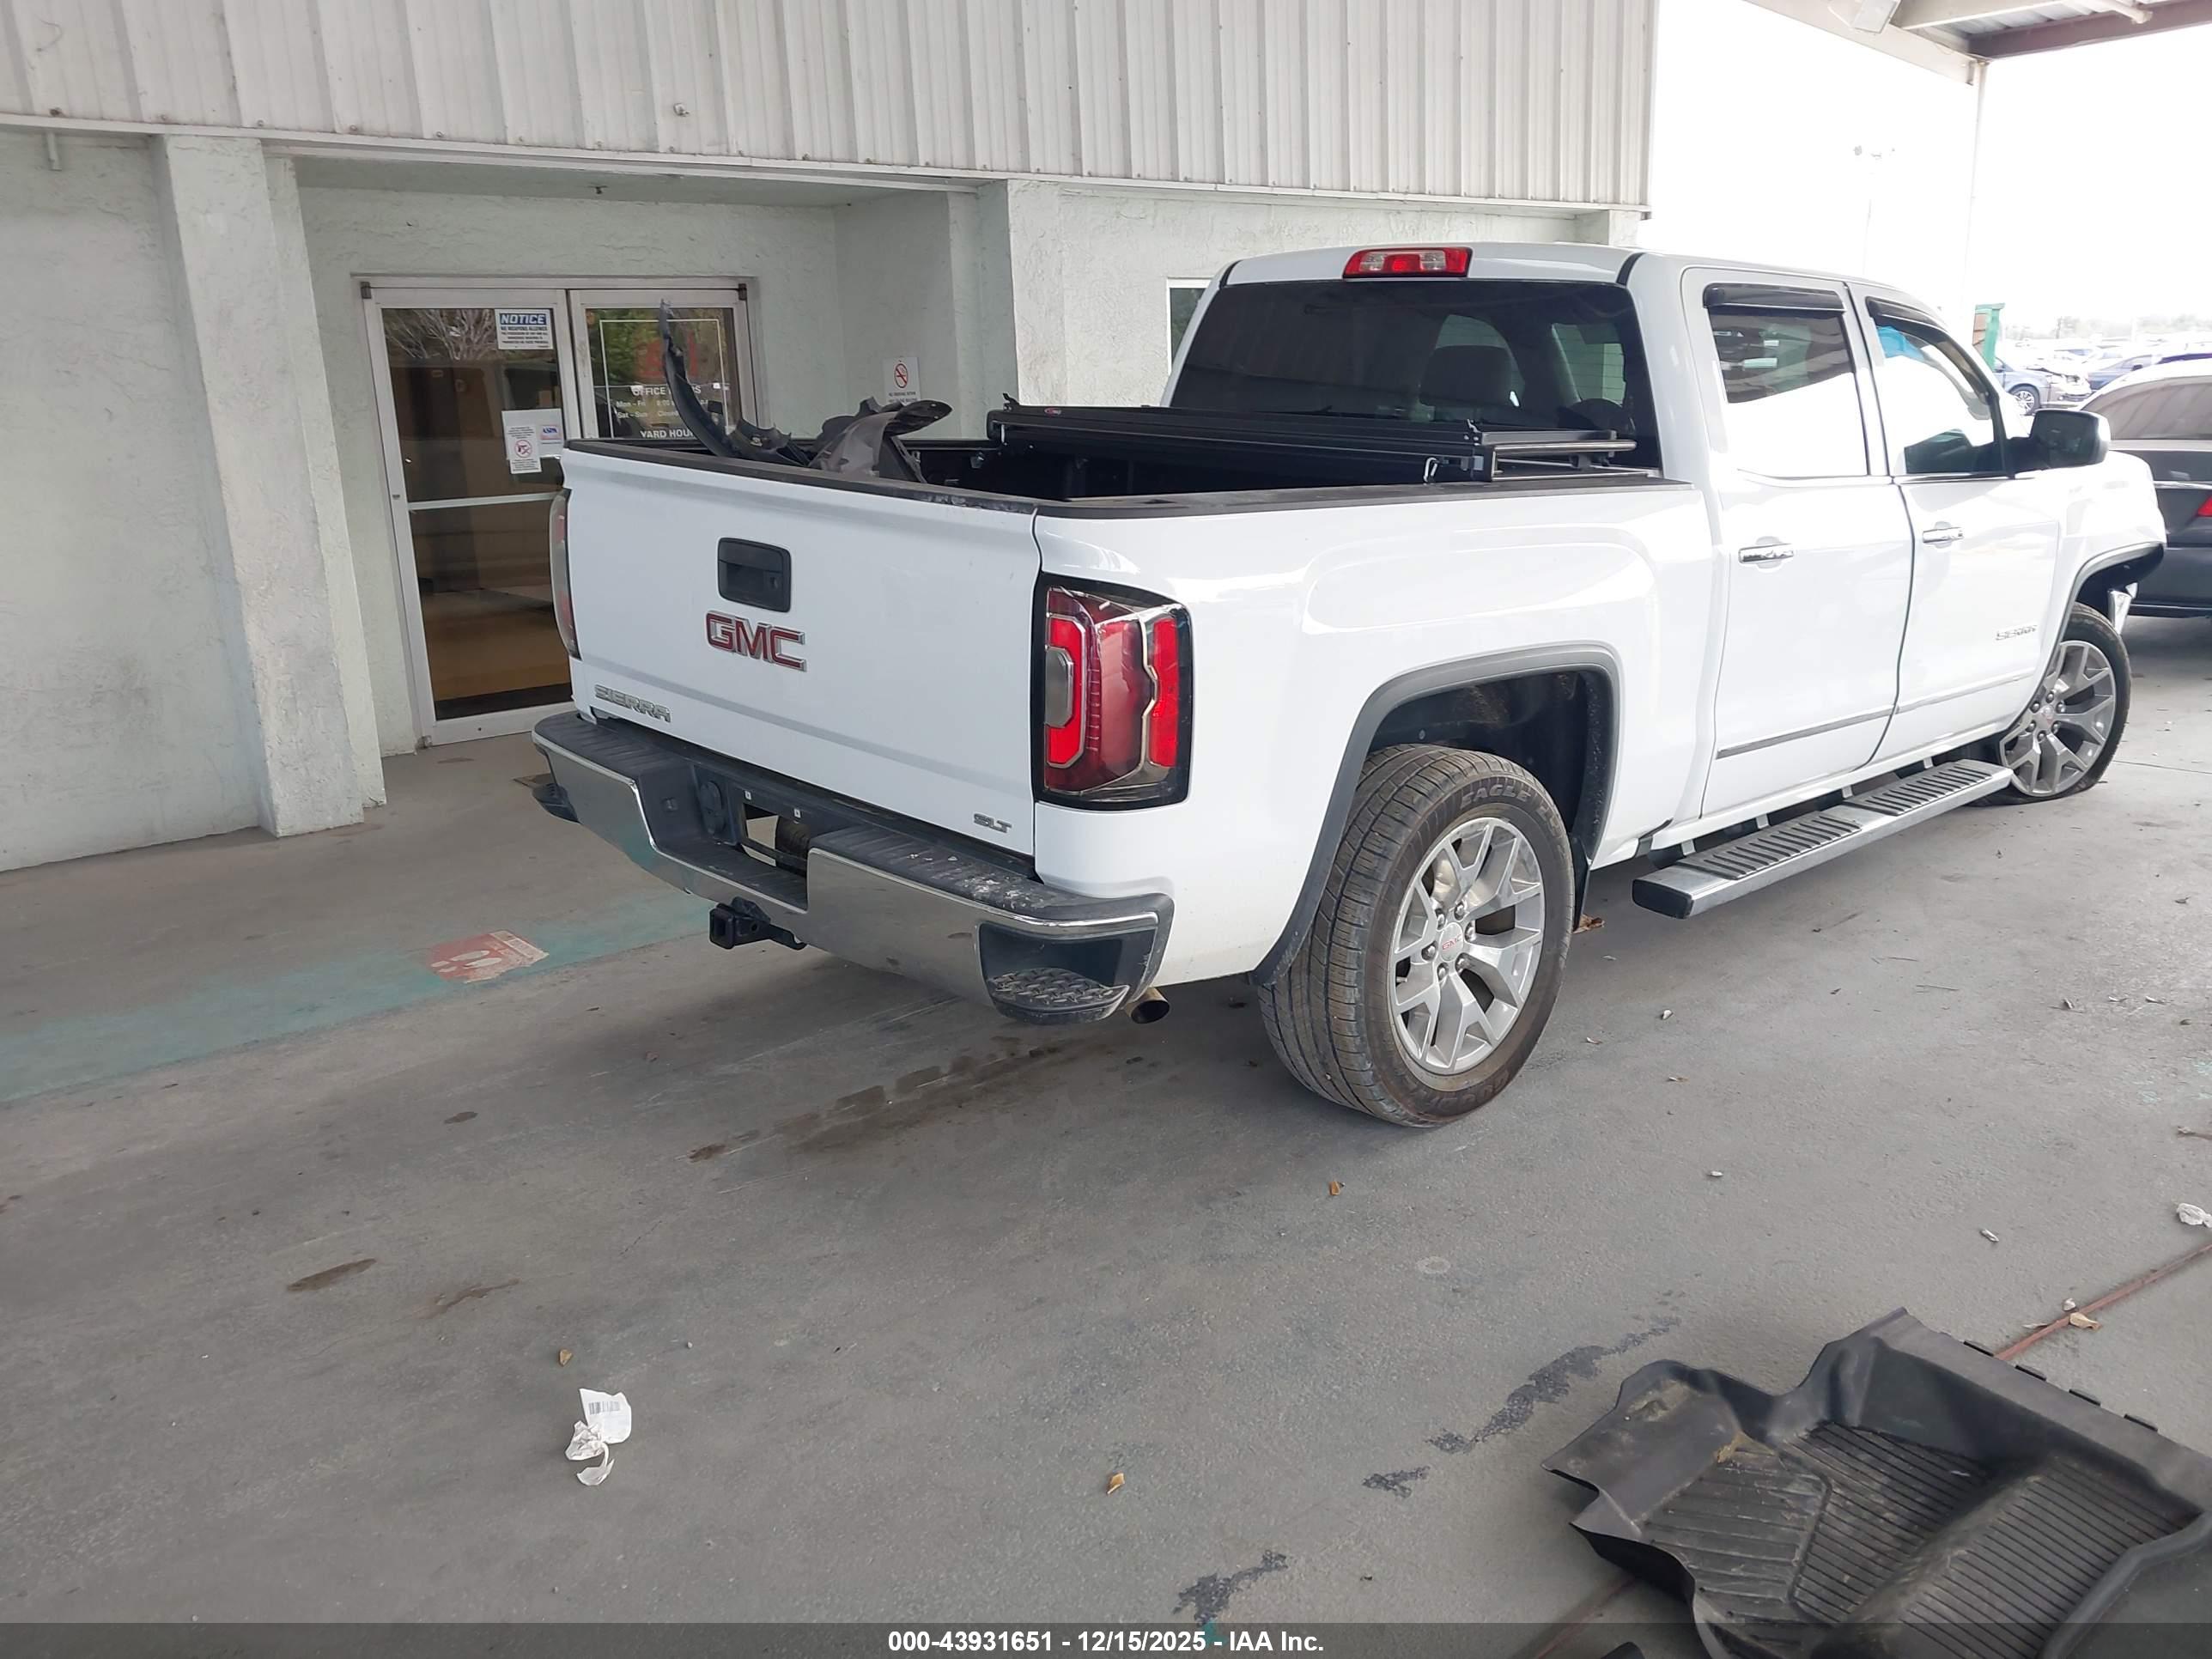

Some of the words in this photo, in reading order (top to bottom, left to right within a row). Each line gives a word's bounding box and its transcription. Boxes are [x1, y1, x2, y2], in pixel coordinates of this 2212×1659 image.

[501, 314, 545, 324] NOTICE
[706, 610, 807, 672] GMC
[594, 684, 672, 723] SIERRA
[1461, 784, 1531, 809] EAGLE
[974, 813, 1012, 834] SLT
